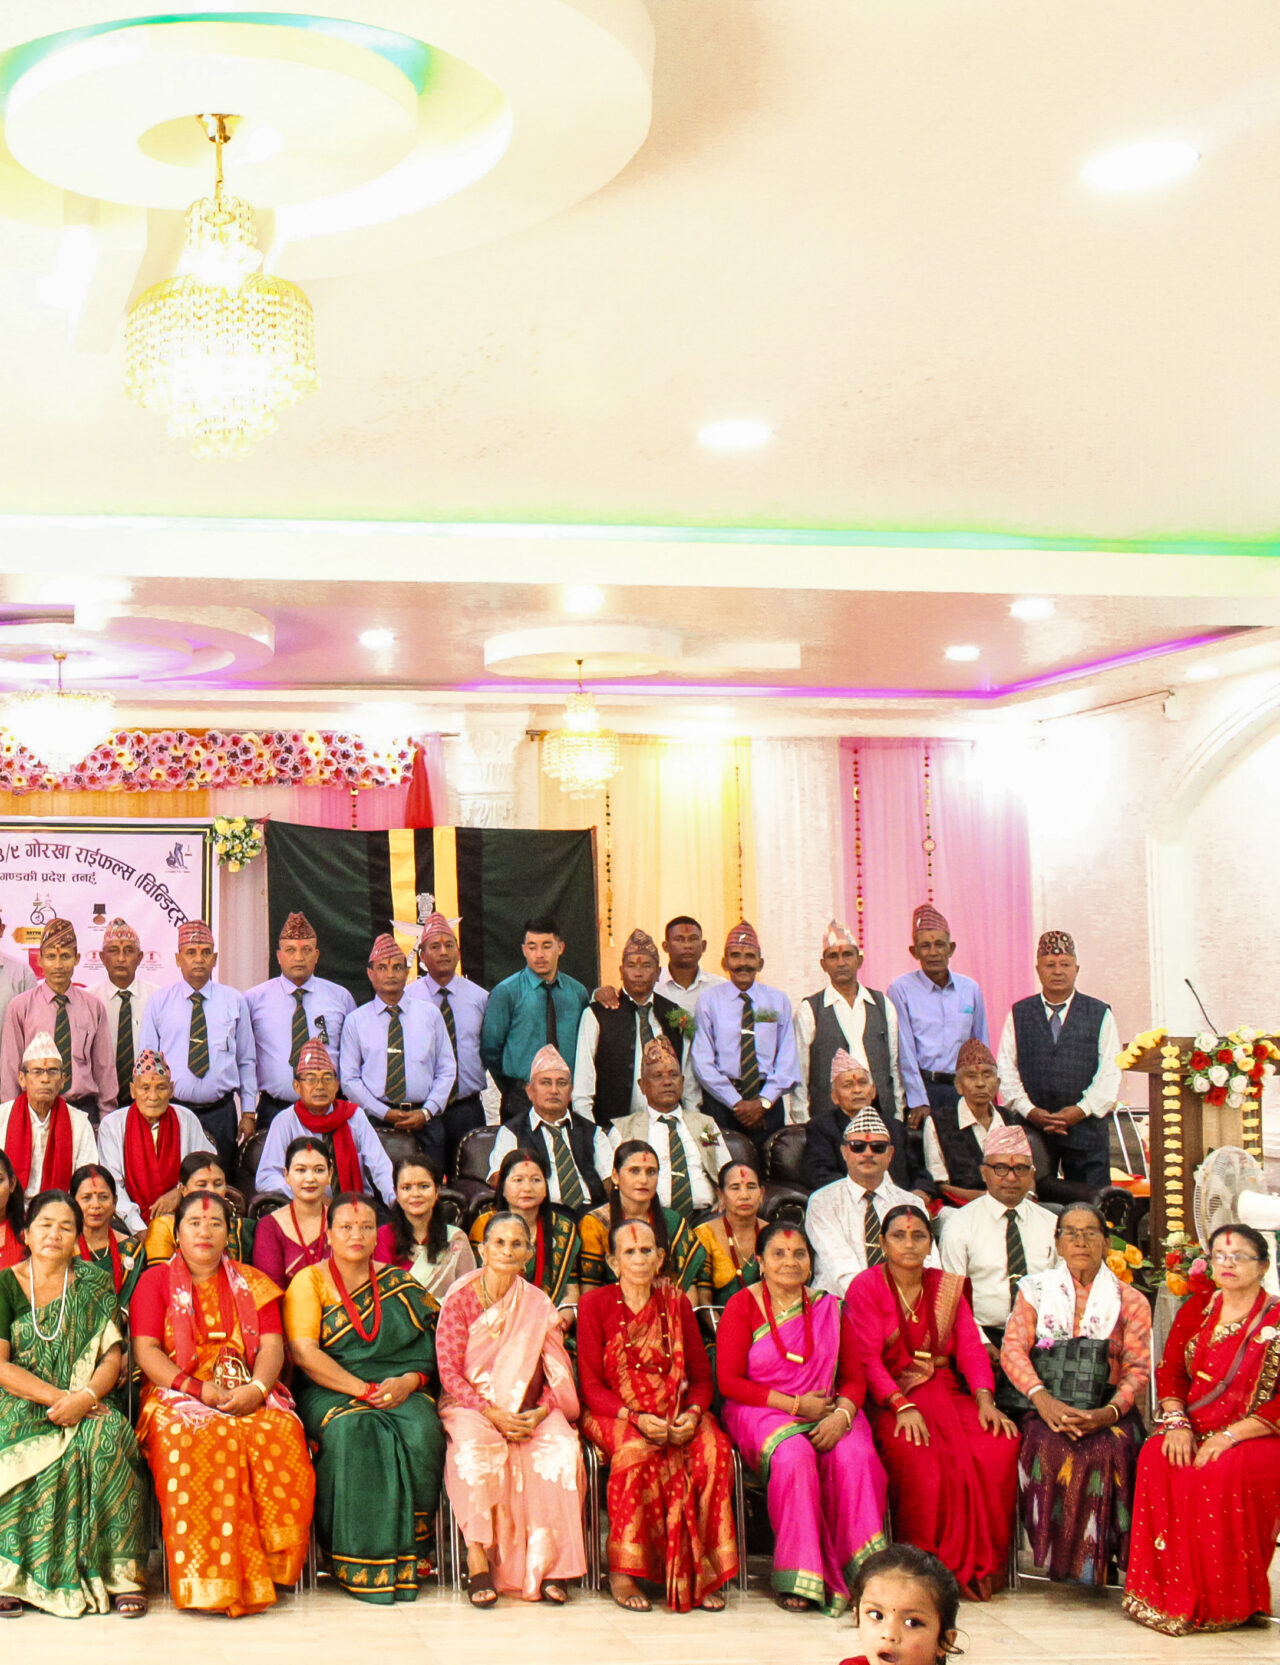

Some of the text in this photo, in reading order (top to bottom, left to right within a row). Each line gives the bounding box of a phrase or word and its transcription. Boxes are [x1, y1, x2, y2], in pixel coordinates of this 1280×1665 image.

[25, 838, 72, 860] गोरखा
[0, 870, 37, 882] गण्डकी
[41, 871, 65, 883] प्रदेश
